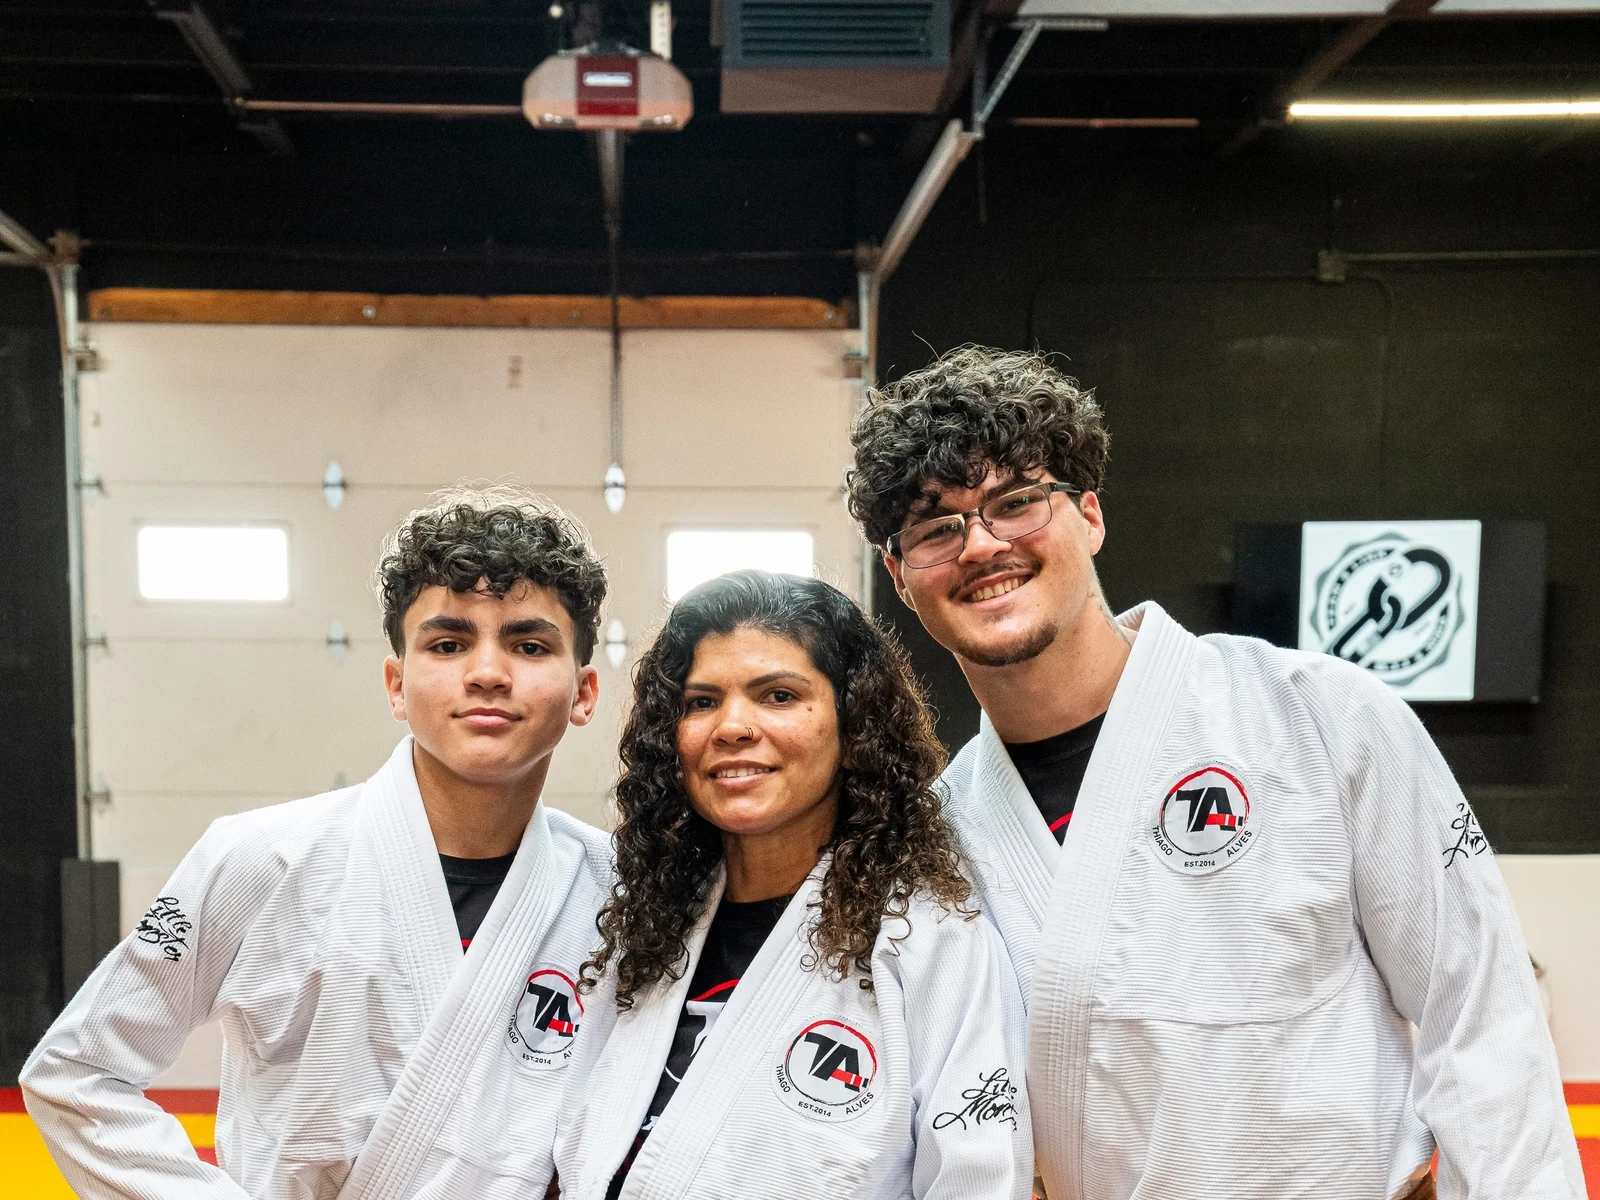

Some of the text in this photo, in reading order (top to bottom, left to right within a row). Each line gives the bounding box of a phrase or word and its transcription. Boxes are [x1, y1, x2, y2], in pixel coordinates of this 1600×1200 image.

[1152, 825, 1253, 868] THIAGO EST.2014 ALVES
[776, 1064, 874, 1117] THIAGO EST.2014 ALVES
